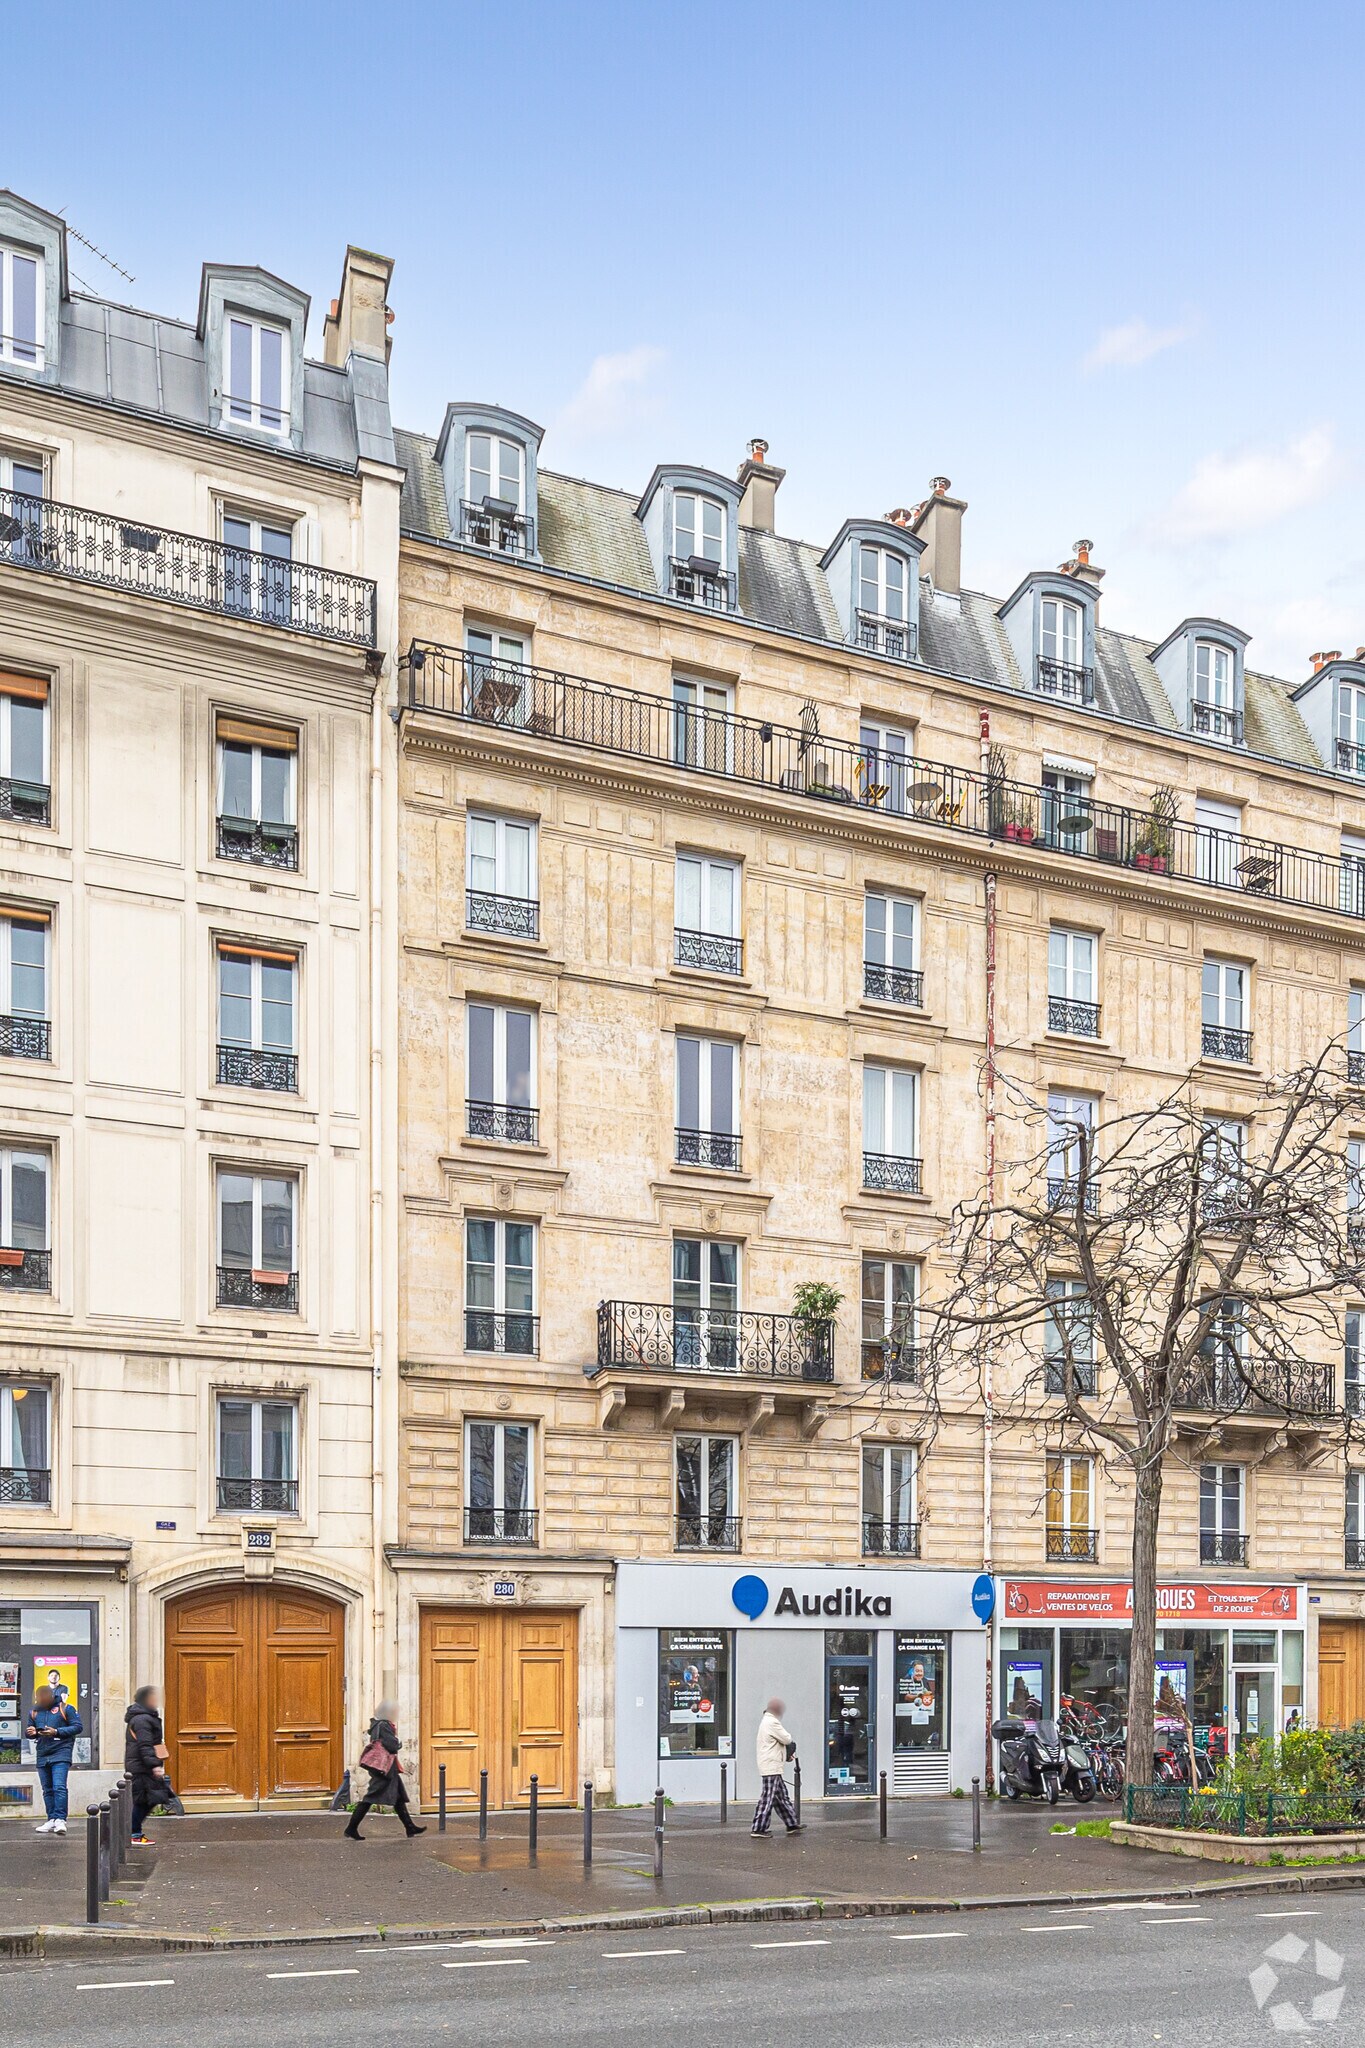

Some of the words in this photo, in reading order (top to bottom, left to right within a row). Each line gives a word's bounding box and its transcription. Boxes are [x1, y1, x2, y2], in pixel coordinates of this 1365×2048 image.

[248, 1534, 270, 1546] 282
[495, 1583, 514, 1595] 280
[774, 1586, 892, 1616] Audika
[1047, 1592, 1100, 1601] REPARATIONS
[1101, 1593, 1111, 1601] ET
[1219, 1595, 1238, 1603] TOUS
[1239, 1595, 1259, 1603] TYPES
[1046, 1602, 1076, 1611] VENTES
[1077, 1603, 1087, 1611] DE
[1089, 1603, 1114, 1611] VELOS
[1213, 1605, 1223, 1613] DE
[1230, 1605, 1254, 1613] ROUES
